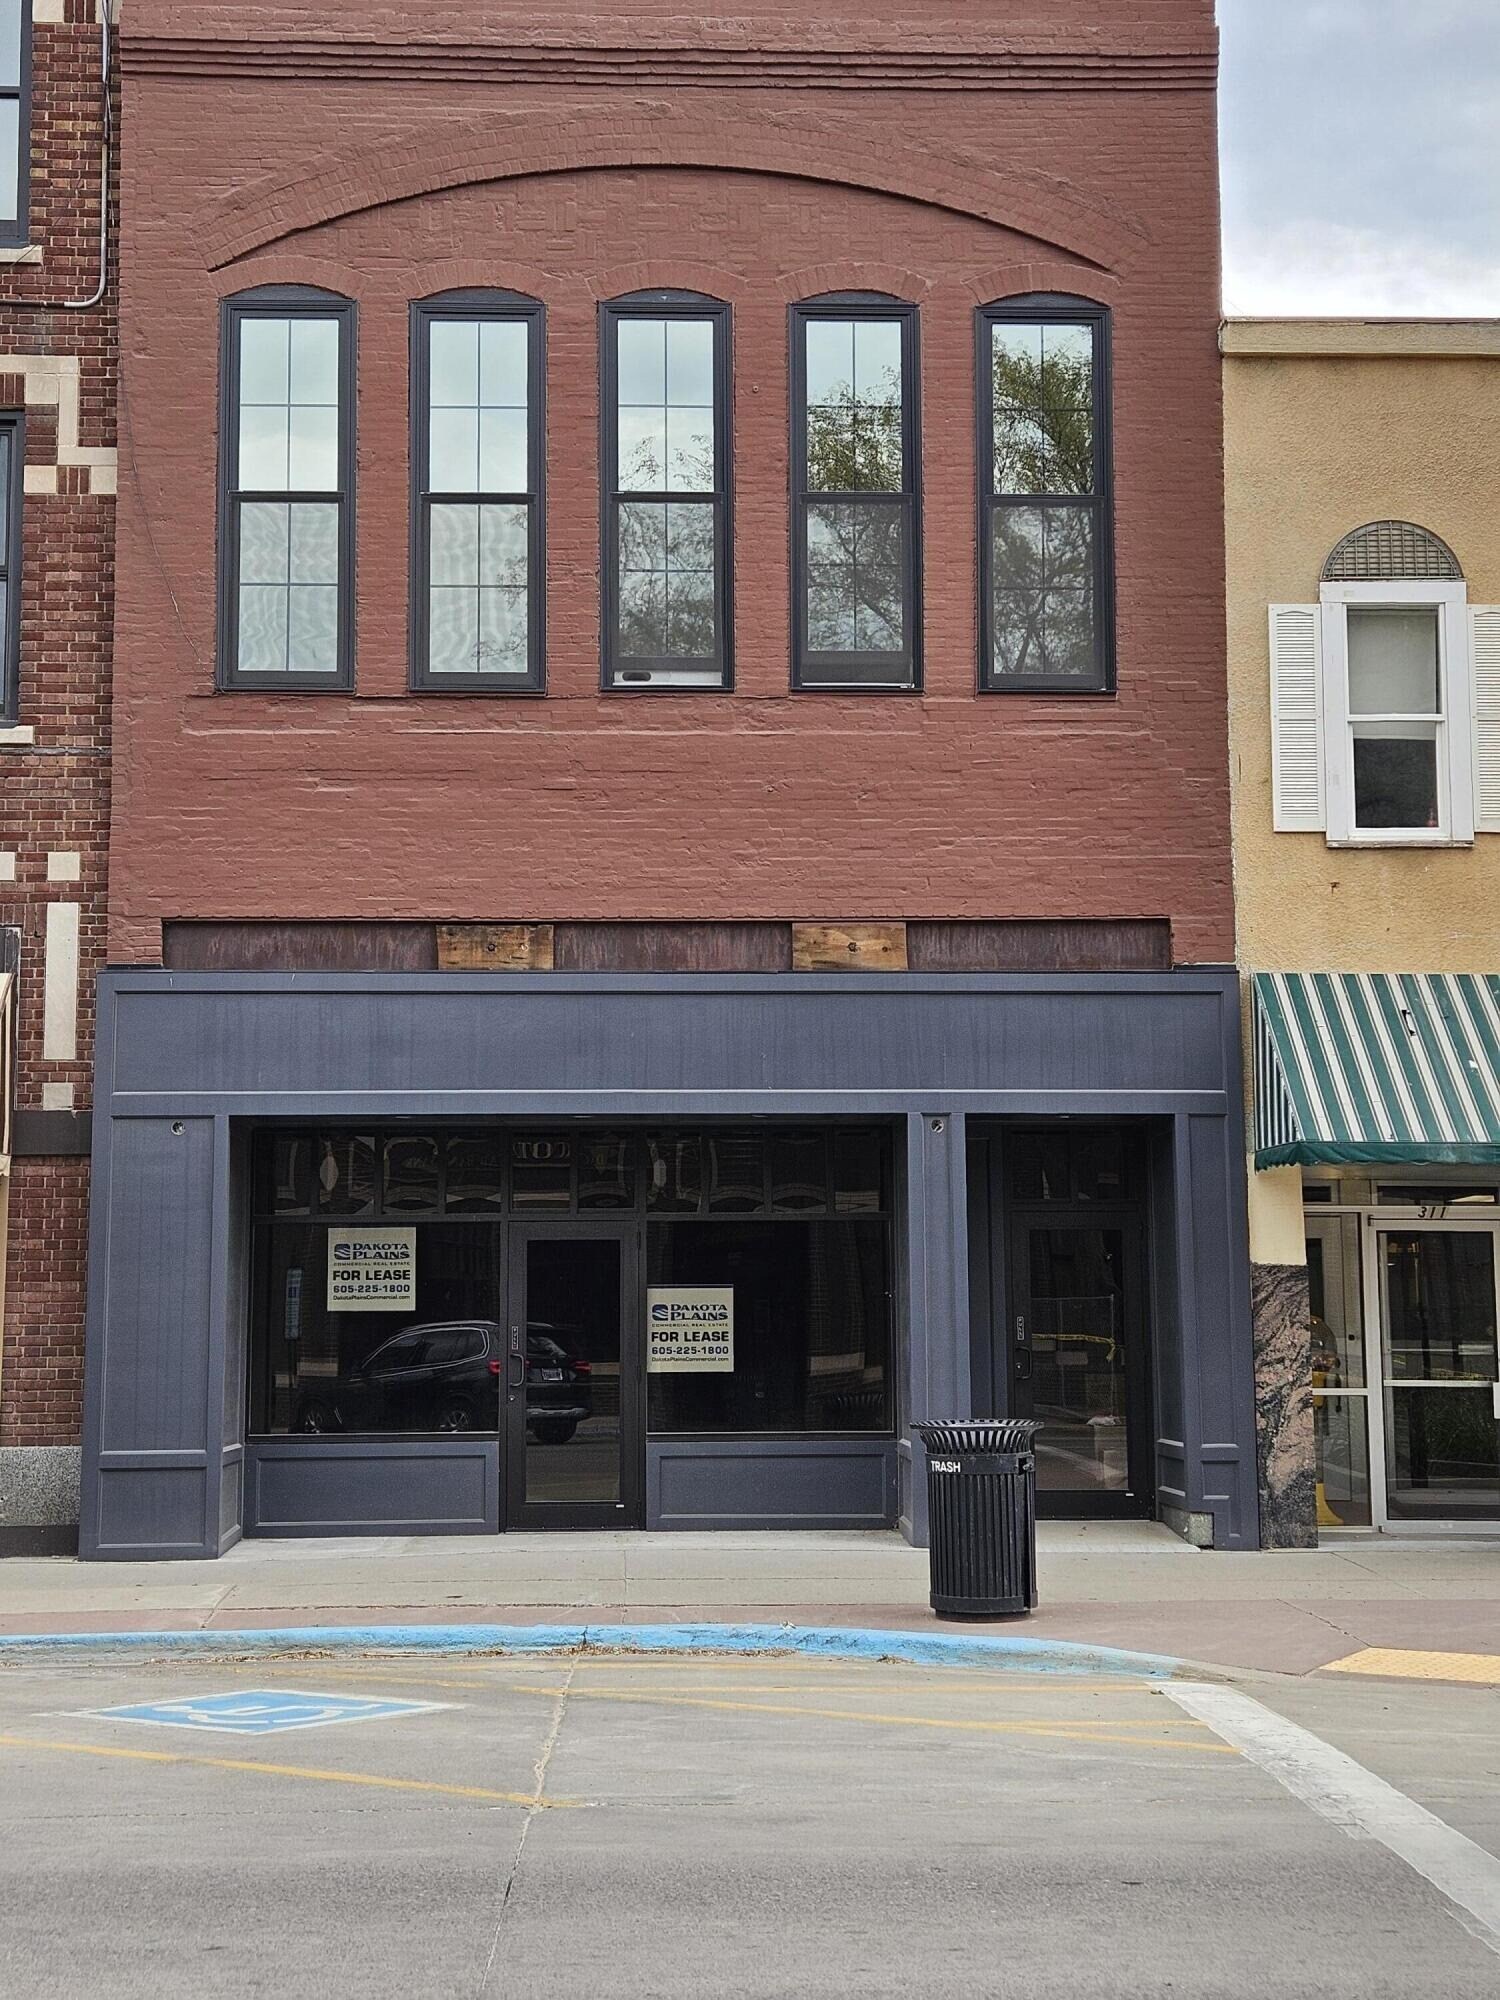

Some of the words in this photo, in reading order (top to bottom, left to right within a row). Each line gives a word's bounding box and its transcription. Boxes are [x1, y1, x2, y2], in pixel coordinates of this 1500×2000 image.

[1417, 1206, 1447, 1219] 311
[352, 1251, 410, 1260] PLAINS
[333, 1270, 360, 1281] FOR
[365, 1269, 411, 1281] LEASE
[333, 1284, 410, 1293] 605-225-1800
[670, 1312, 729, 1321] PLAINS
[651, 1331, 679, 1342] FOR
[684, 1331, 730, 1342] LEASE
[651, 1346, 729, 1355] 605-225-1800
[930, 1460, 961, 1473] TRASH
